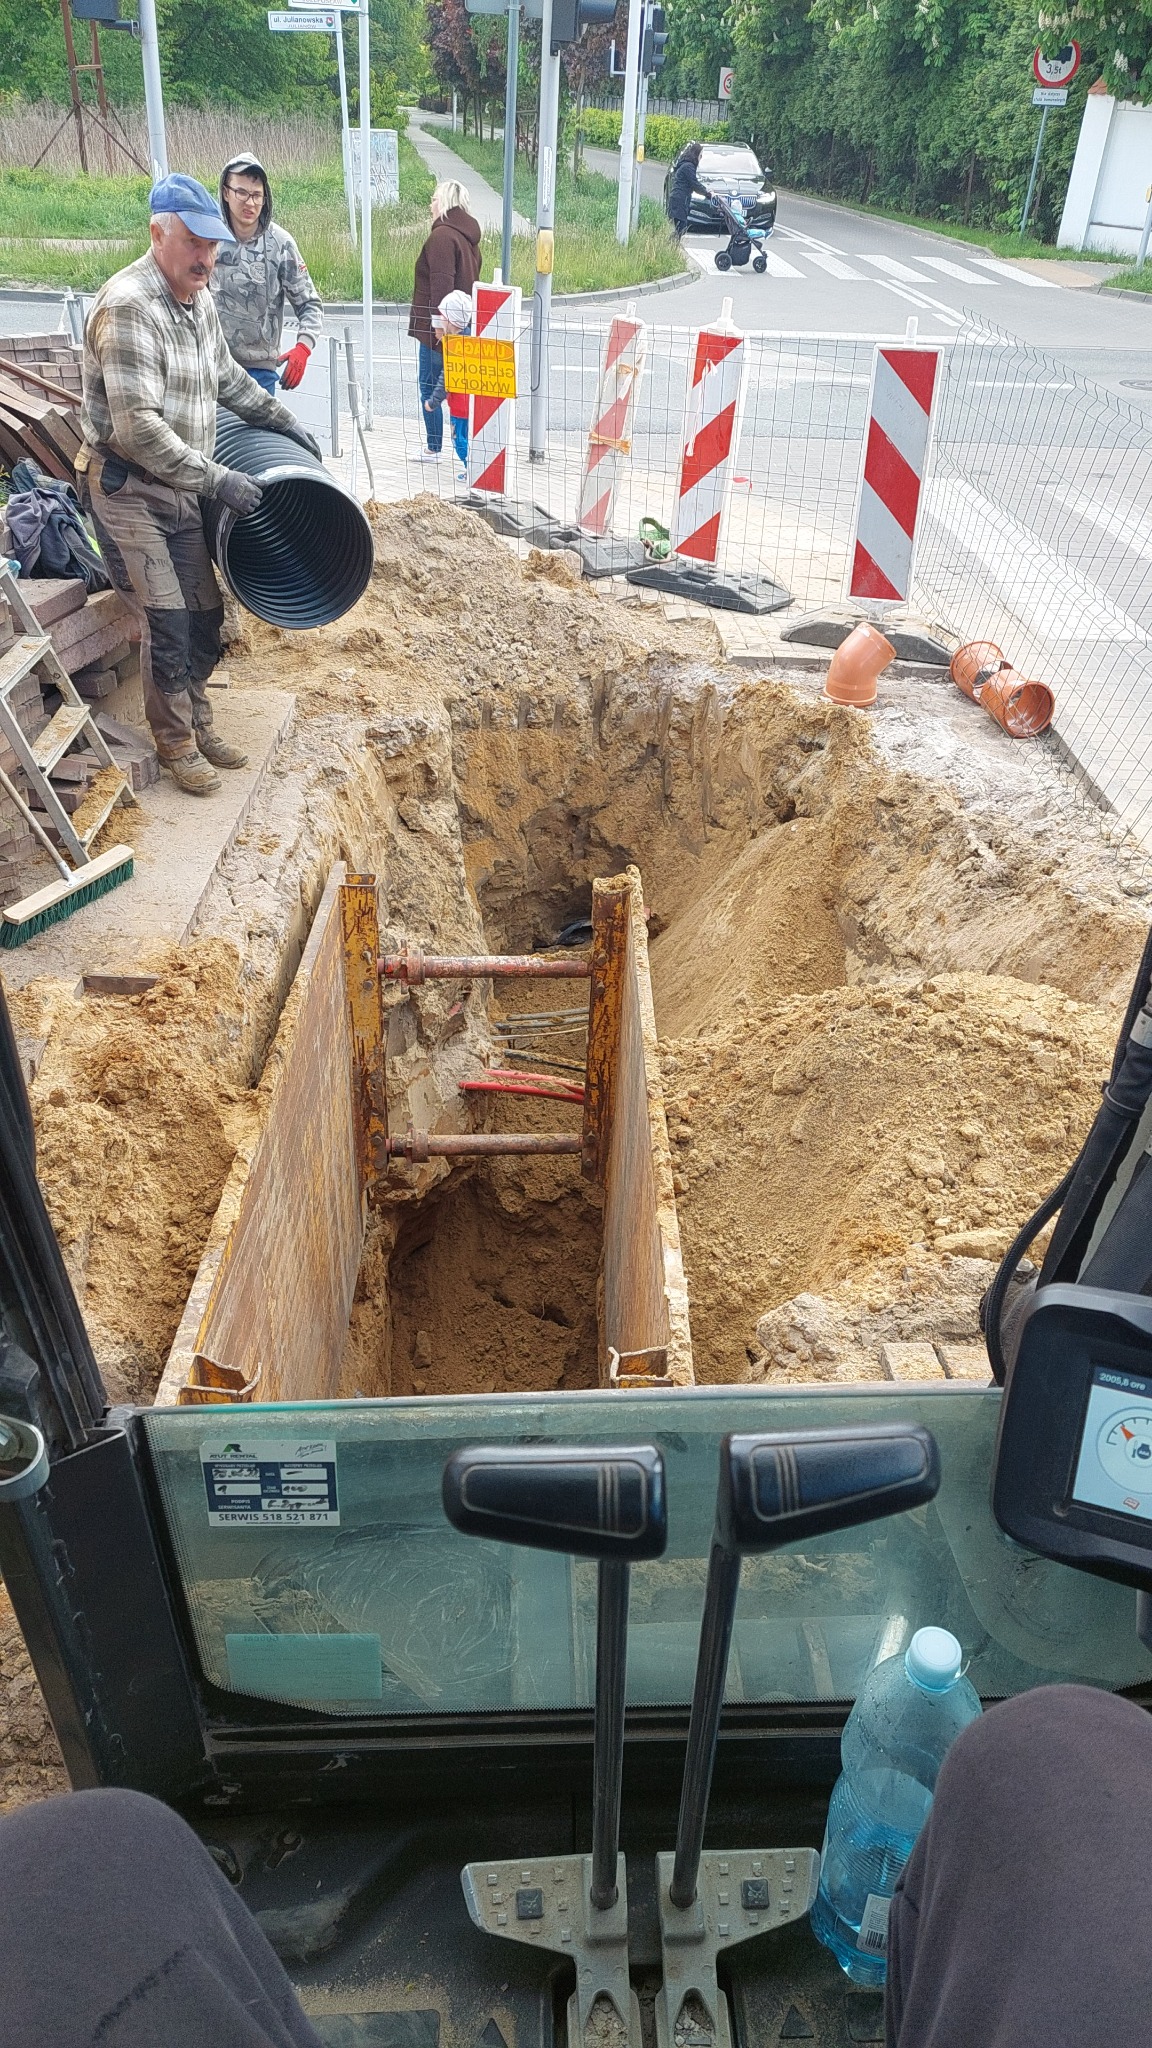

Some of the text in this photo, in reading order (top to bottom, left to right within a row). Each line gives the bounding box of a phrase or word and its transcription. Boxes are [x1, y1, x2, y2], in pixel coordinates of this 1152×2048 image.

[283, 16, 324, 24] Julianowska
[1046, 63, 1062, 75] 3,5t
[218, 1513, 329, 1521] SERWIS 518 521 871
